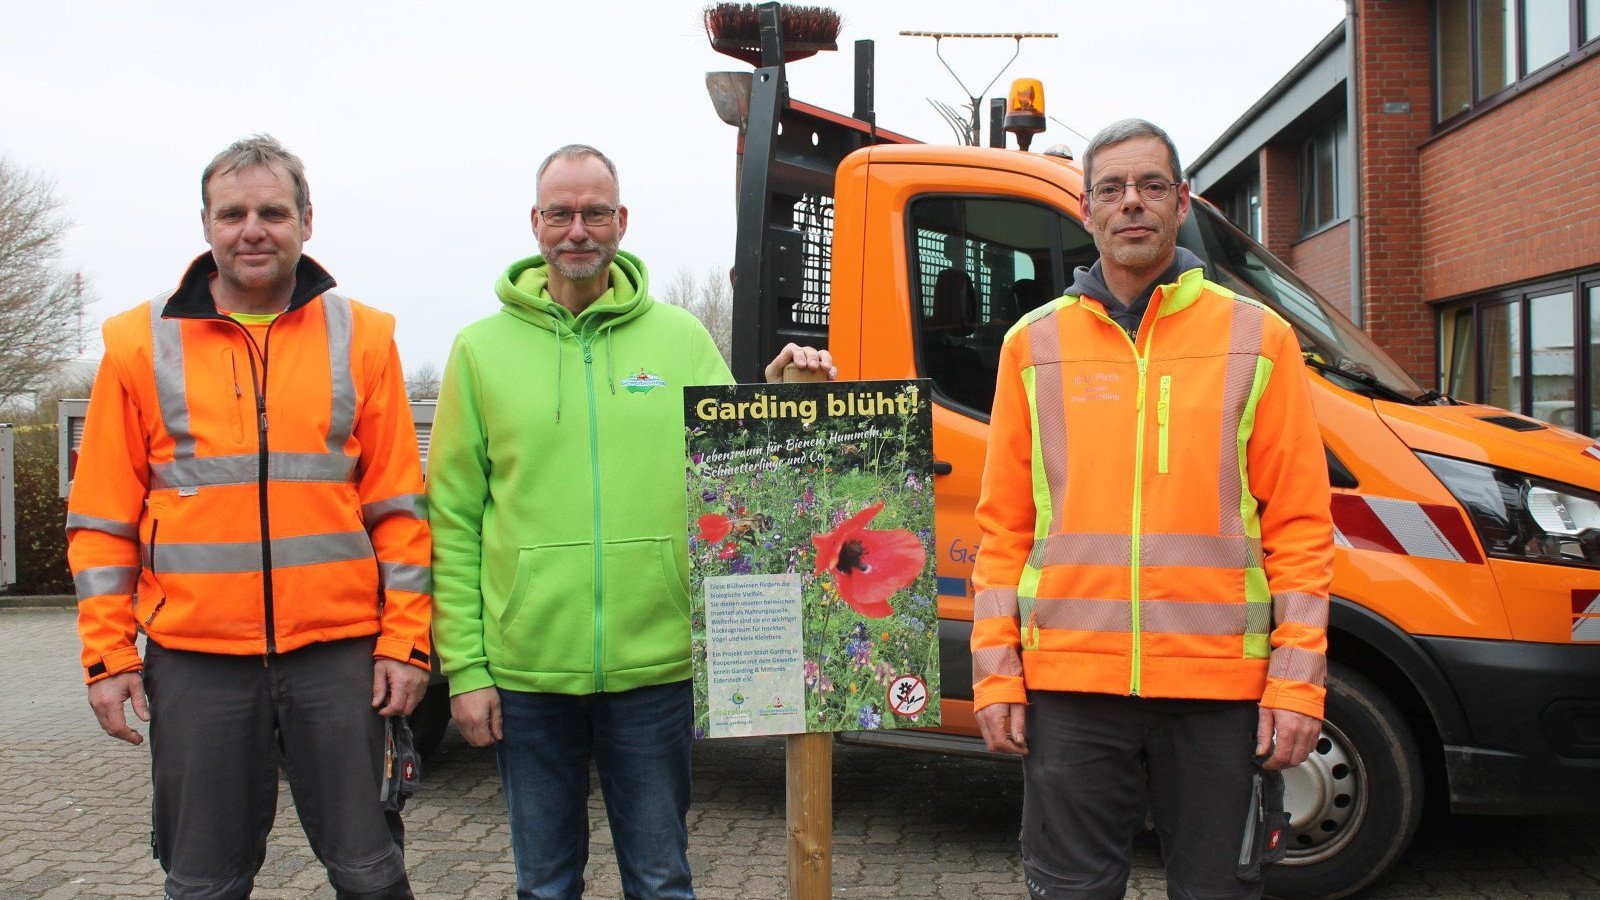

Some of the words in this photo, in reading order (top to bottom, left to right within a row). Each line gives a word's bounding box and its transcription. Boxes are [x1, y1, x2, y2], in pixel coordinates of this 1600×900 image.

[696, 395, 817, 424] Garding
[827, 392, 918, 416] blüht!
[700, 447, 763, 464] Lebensraum
[766, 441, 783, 457] für
[785, 437, 826, 452] Bienen,
[828, 425, 882, 444] Hummeln,
[702, 457, 784, 480] Schmetterlinge
[787, 453, 806, 465] und
[710, 592, 741, 600] biologische
[771, 615, 798, 623] wichtiger
[722, 650, 742, 658] Projekt
[769, 648, 792, 656] Garding
[712, 659, 747, 667] Kooperation
[731, 667, 754, 675] Garding
[713, 676, 742, 684] Eiderstedt
